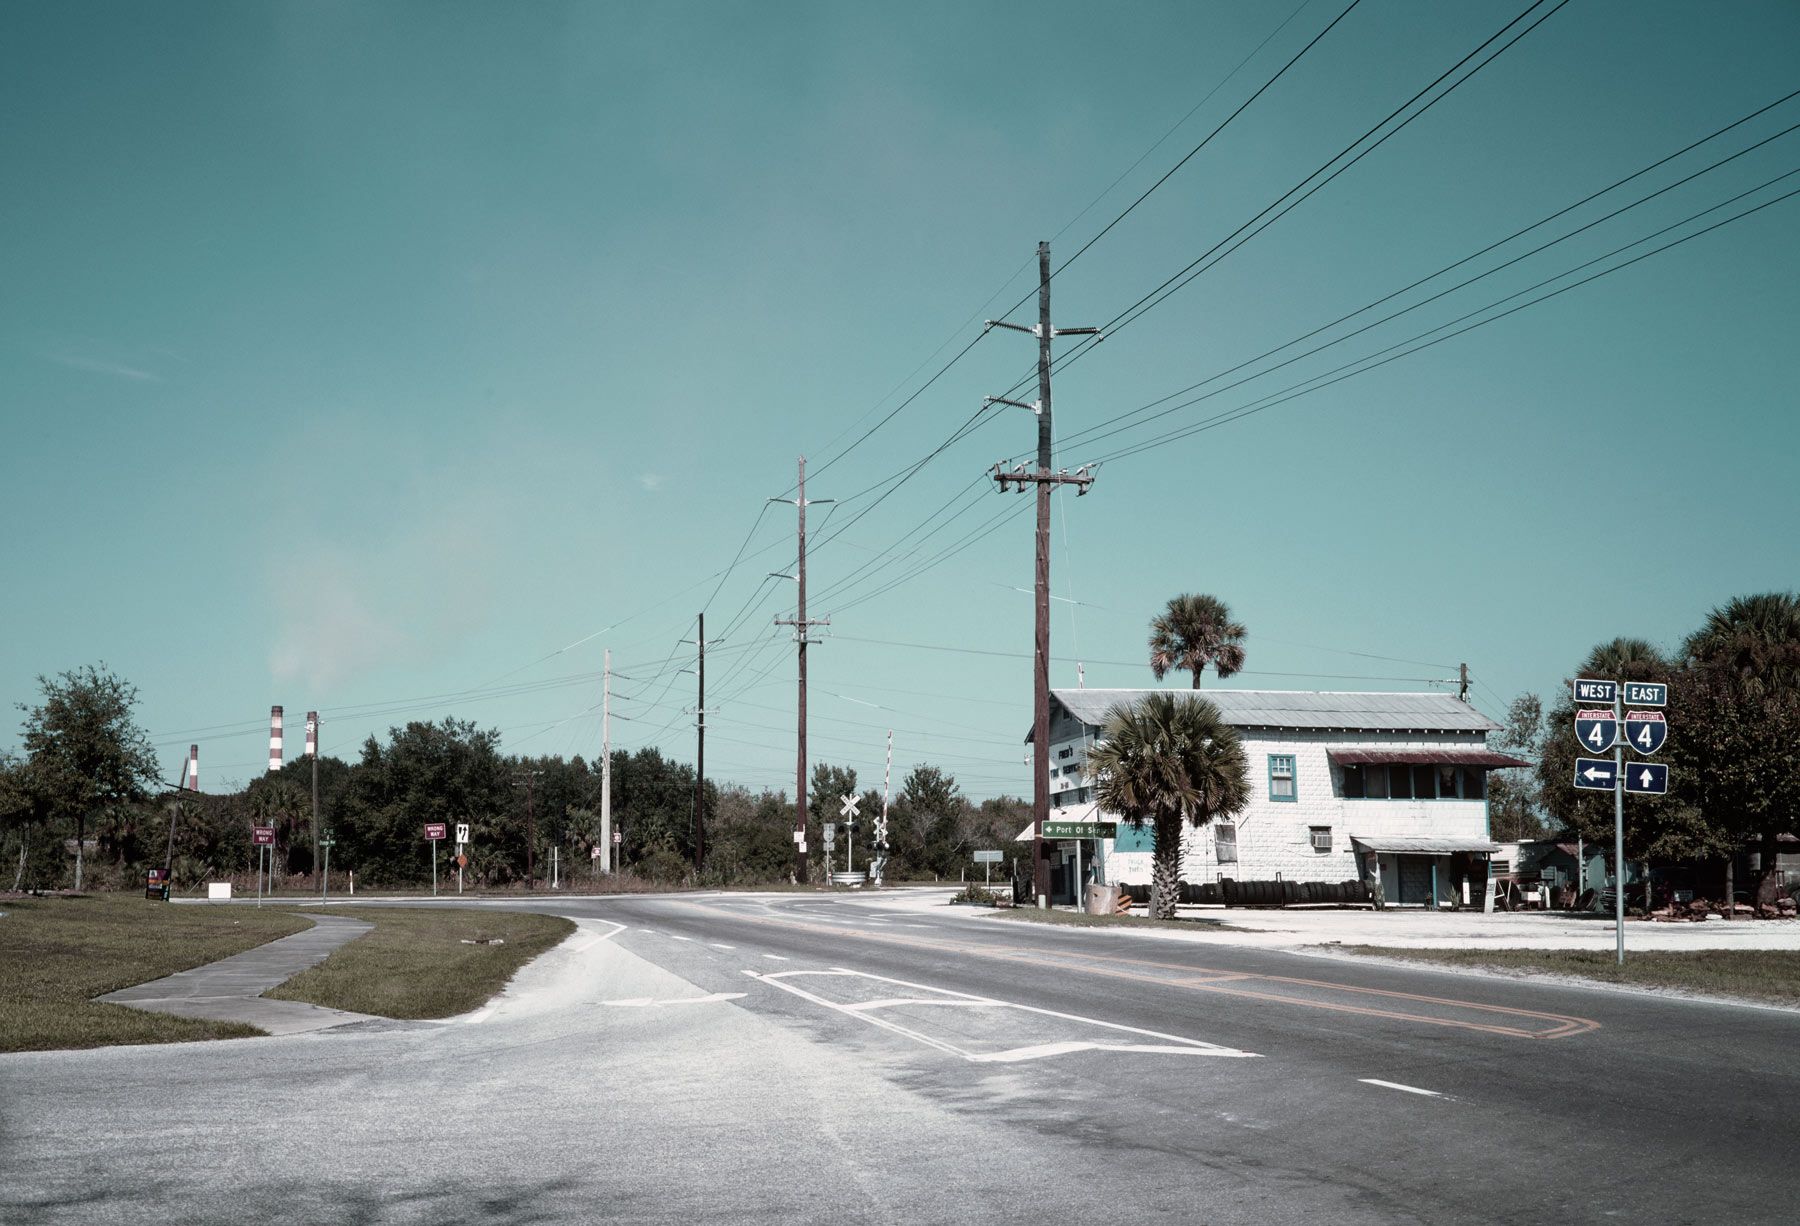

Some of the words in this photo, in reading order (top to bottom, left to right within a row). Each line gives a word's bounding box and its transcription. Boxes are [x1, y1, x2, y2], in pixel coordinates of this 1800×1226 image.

[1580, 684, 1611, 698] WEST
[1631, 687, 1660, 701] EAST
[1588, 723, 1603, 746] 4
[1637, 724, 1652, 747] 4
[1056, 826, 1071, 834] Port
